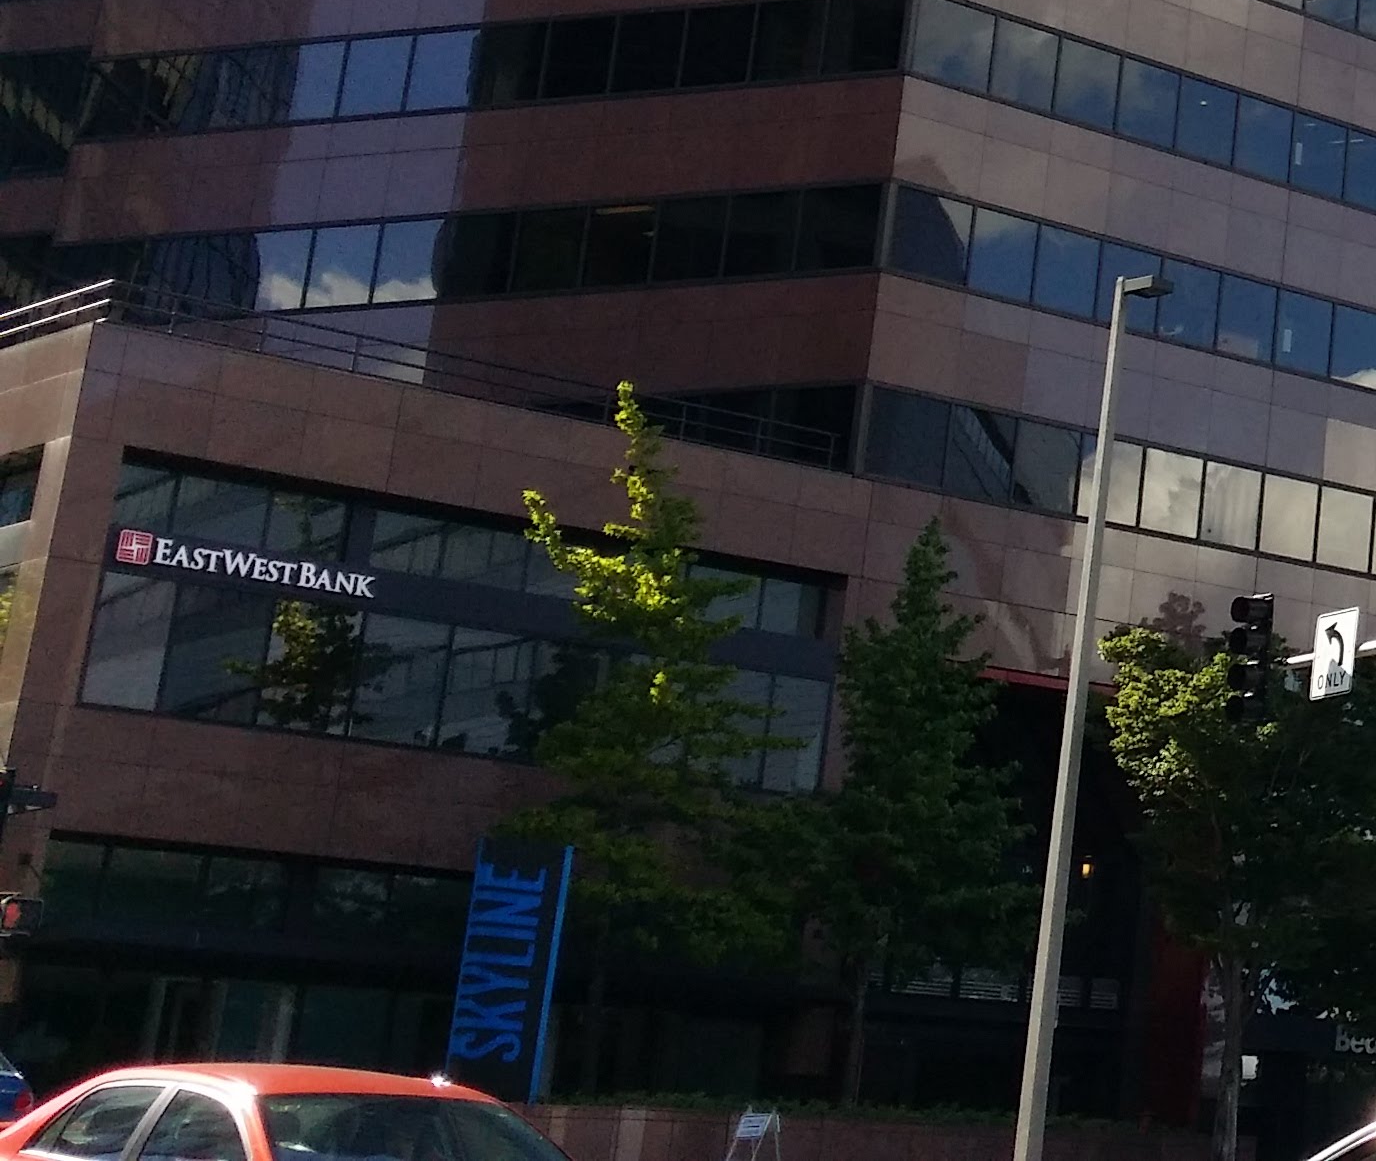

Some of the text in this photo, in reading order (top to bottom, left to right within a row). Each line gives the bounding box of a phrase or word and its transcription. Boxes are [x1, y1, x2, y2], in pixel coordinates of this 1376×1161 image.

[296, 561, 376, 599] BANK
[1317, 670, 1347, 690] ONLY
[449, 863, 547, 1064] SKYLINE
